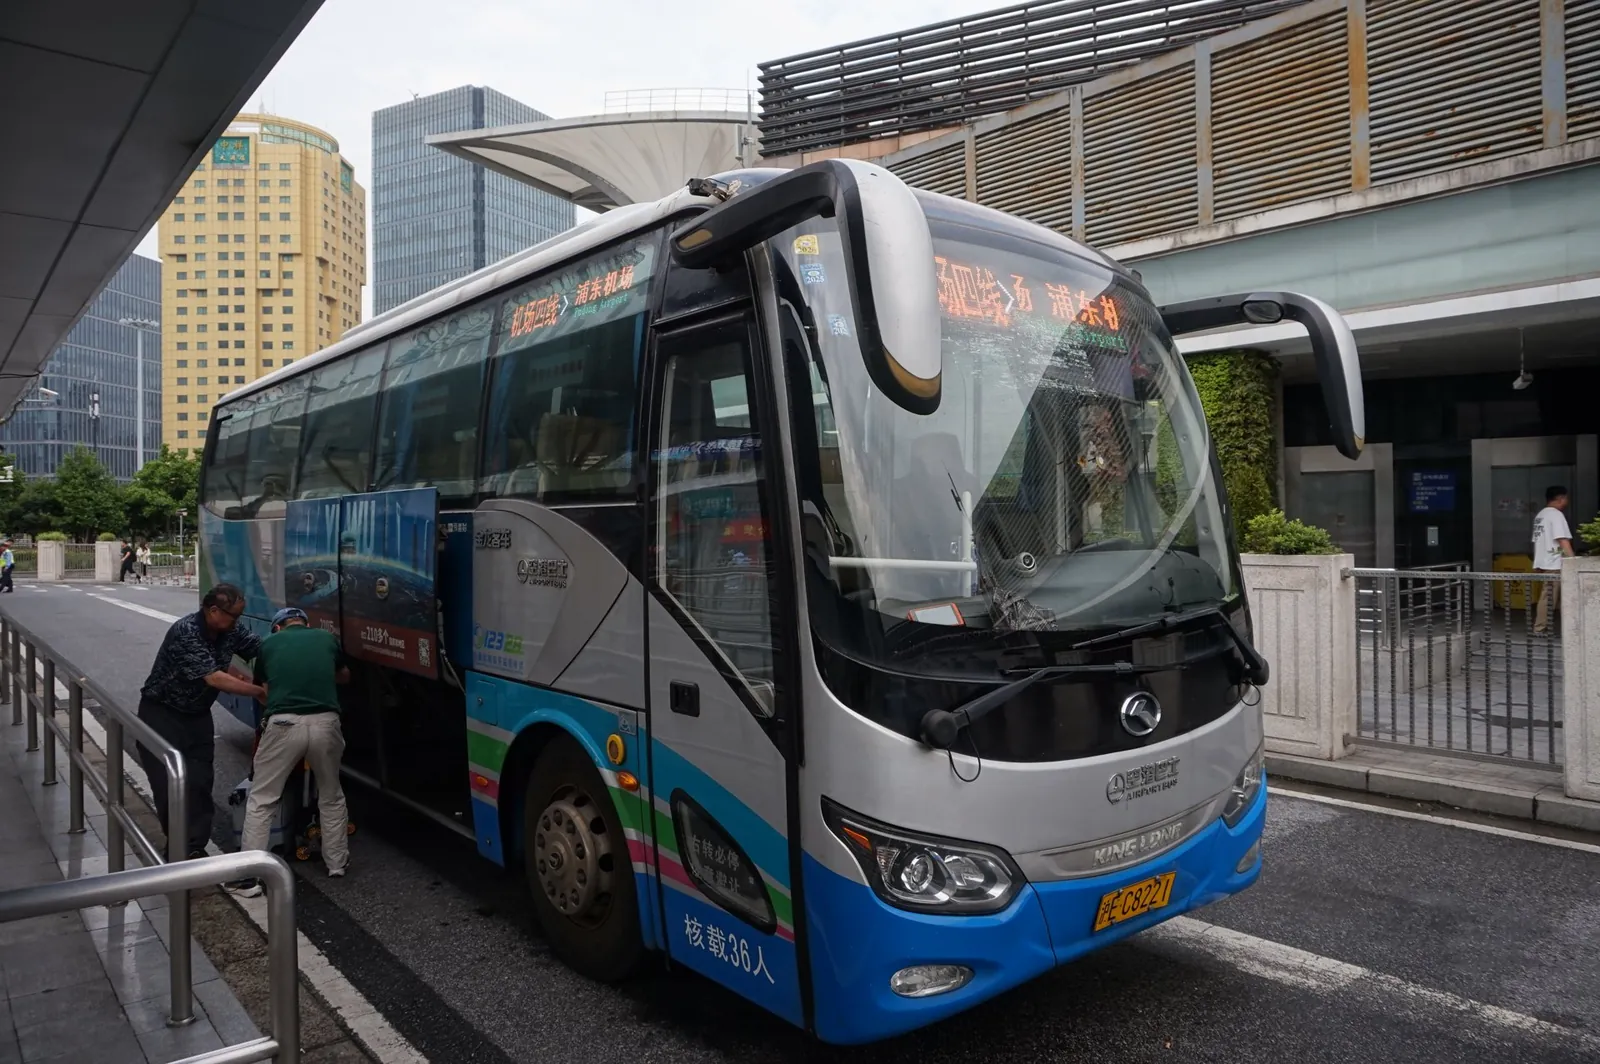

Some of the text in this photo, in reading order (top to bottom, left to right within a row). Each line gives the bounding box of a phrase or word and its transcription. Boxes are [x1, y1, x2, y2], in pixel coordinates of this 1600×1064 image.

[510, 265, 635, 337] 机场四线 浦东机场
[1126, 756, 1180, 788] 空港巴士
[1126, 777, 1178, 801] AIRPORT BUS
[1093, 823, 1182, 866] KING LONG
[684, 913, 775, 985] 核载36人
